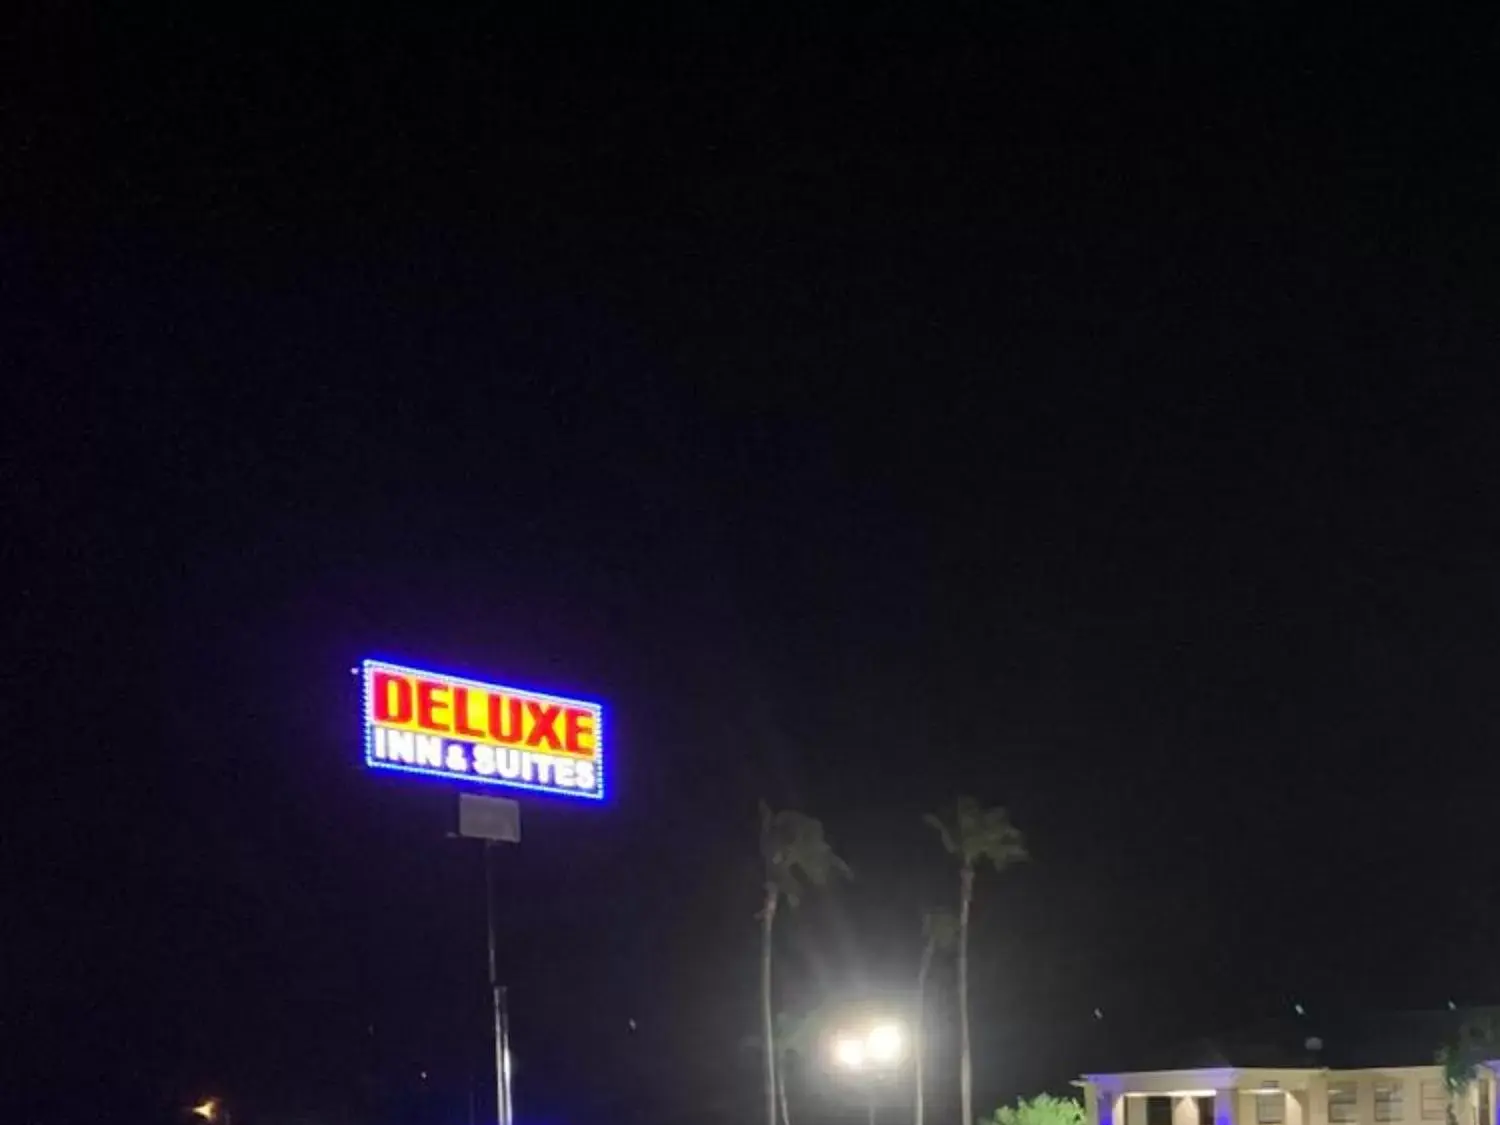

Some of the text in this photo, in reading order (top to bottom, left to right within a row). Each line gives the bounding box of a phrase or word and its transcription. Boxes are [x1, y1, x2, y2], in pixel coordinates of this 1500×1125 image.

[372, 670, 594, 757] DELUXE
[374, 726, 595, 789] INN & SUITES
